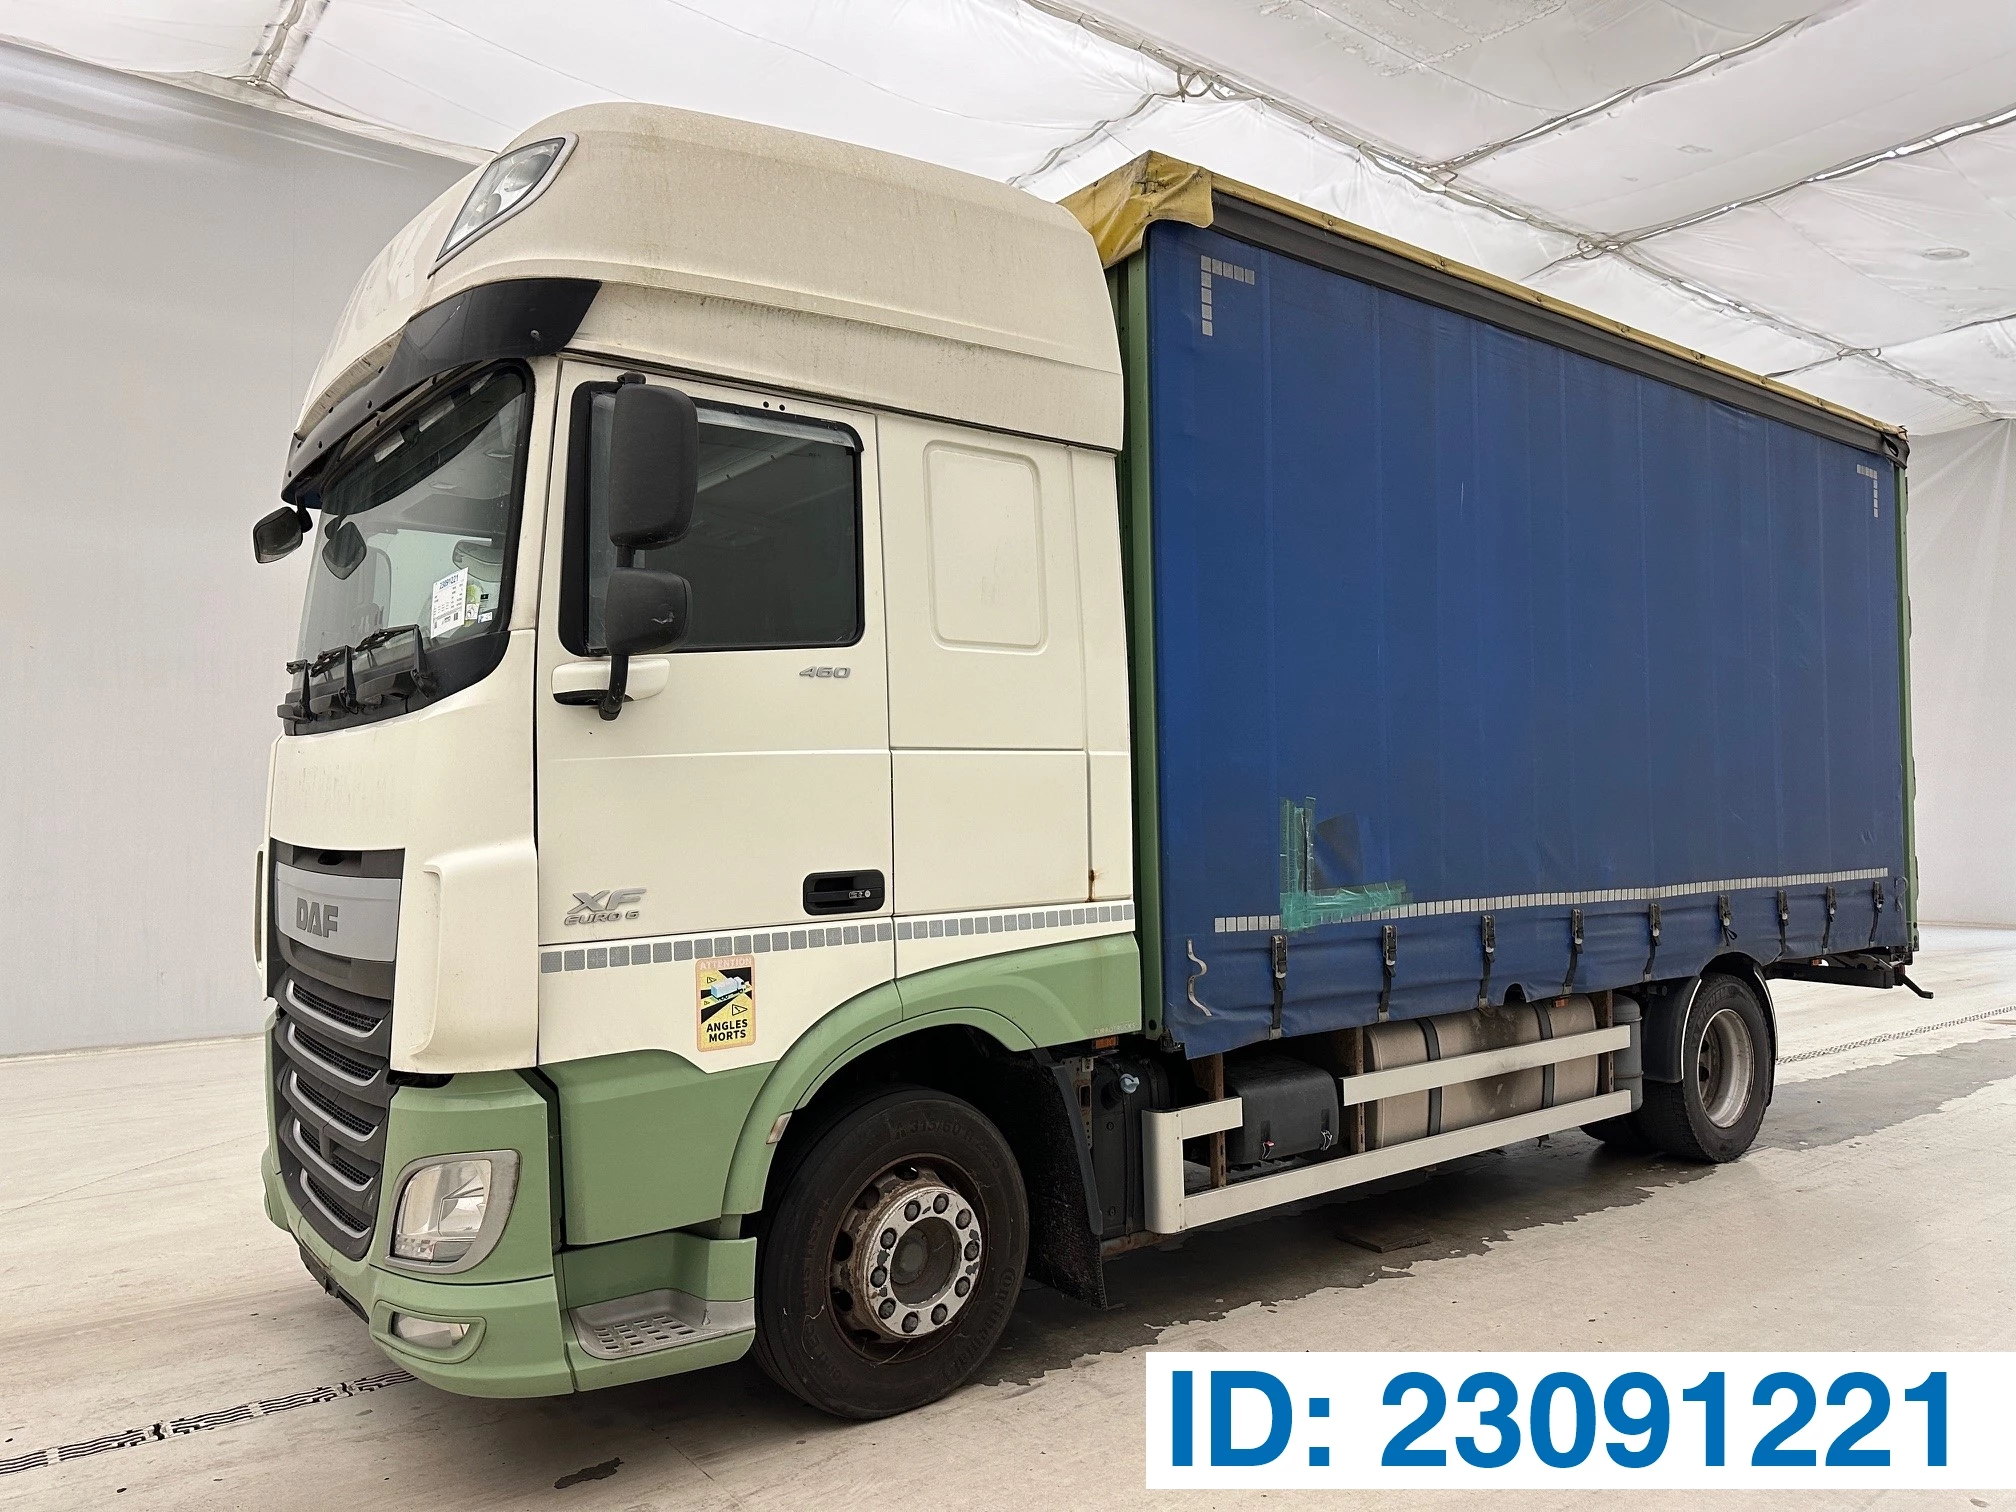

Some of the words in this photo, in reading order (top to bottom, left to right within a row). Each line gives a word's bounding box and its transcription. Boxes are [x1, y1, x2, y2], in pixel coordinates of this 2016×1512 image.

[799, 666, 851, 678] 460
[567, 888, 647, 915] XF
[296, 897, 339, 938] DAF
[564, 912, 622, 926] EURO
[625, 910, 639, 920] 6
[701, 957, 752, 969] ATTENTION
[706, 1019, 748, 1033] ANGLES
[1094, 1022, 1136, 1035] TURBOTRUCKS
[709, 1030, 746, 1043] MORTS
